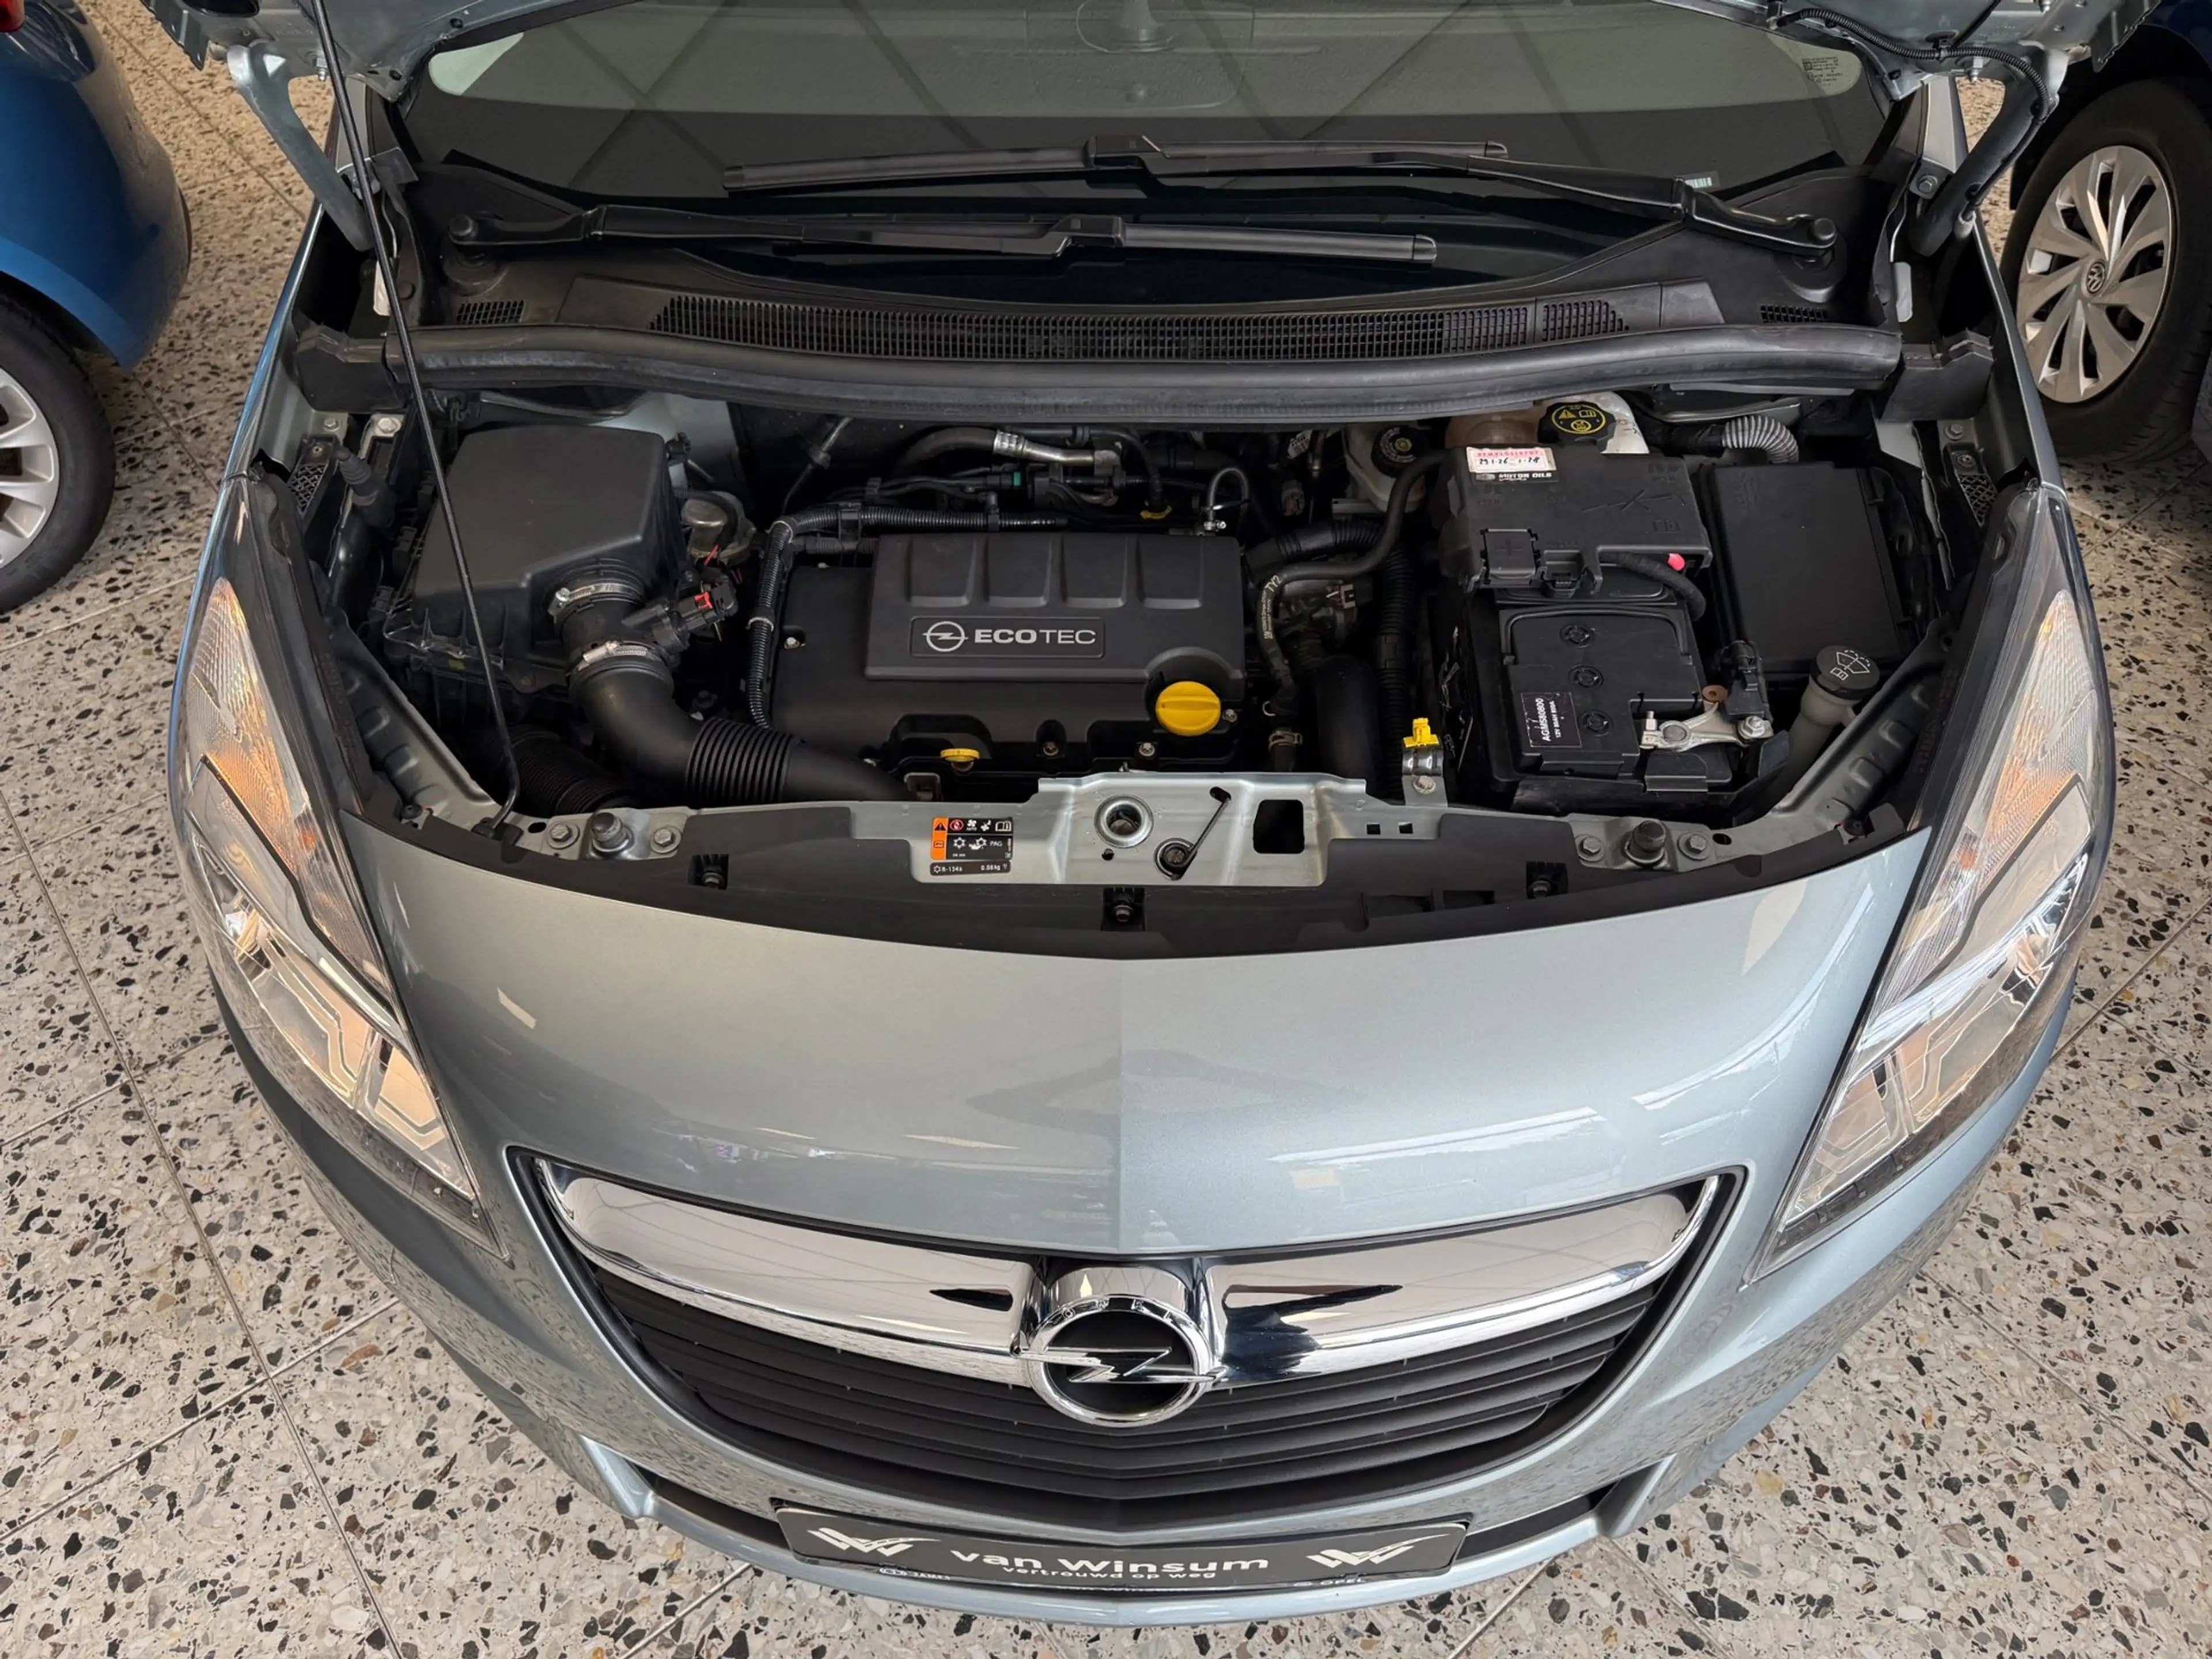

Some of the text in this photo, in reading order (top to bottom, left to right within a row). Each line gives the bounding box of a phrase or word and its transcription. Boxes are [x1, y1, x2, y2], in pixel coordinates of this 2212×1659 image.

[975, 629, 1096, 644] ECOTEC
[950, 1550, 1268, 1573] van Winsum
[1002, 1567, 1123, 1578] vertrouwd
